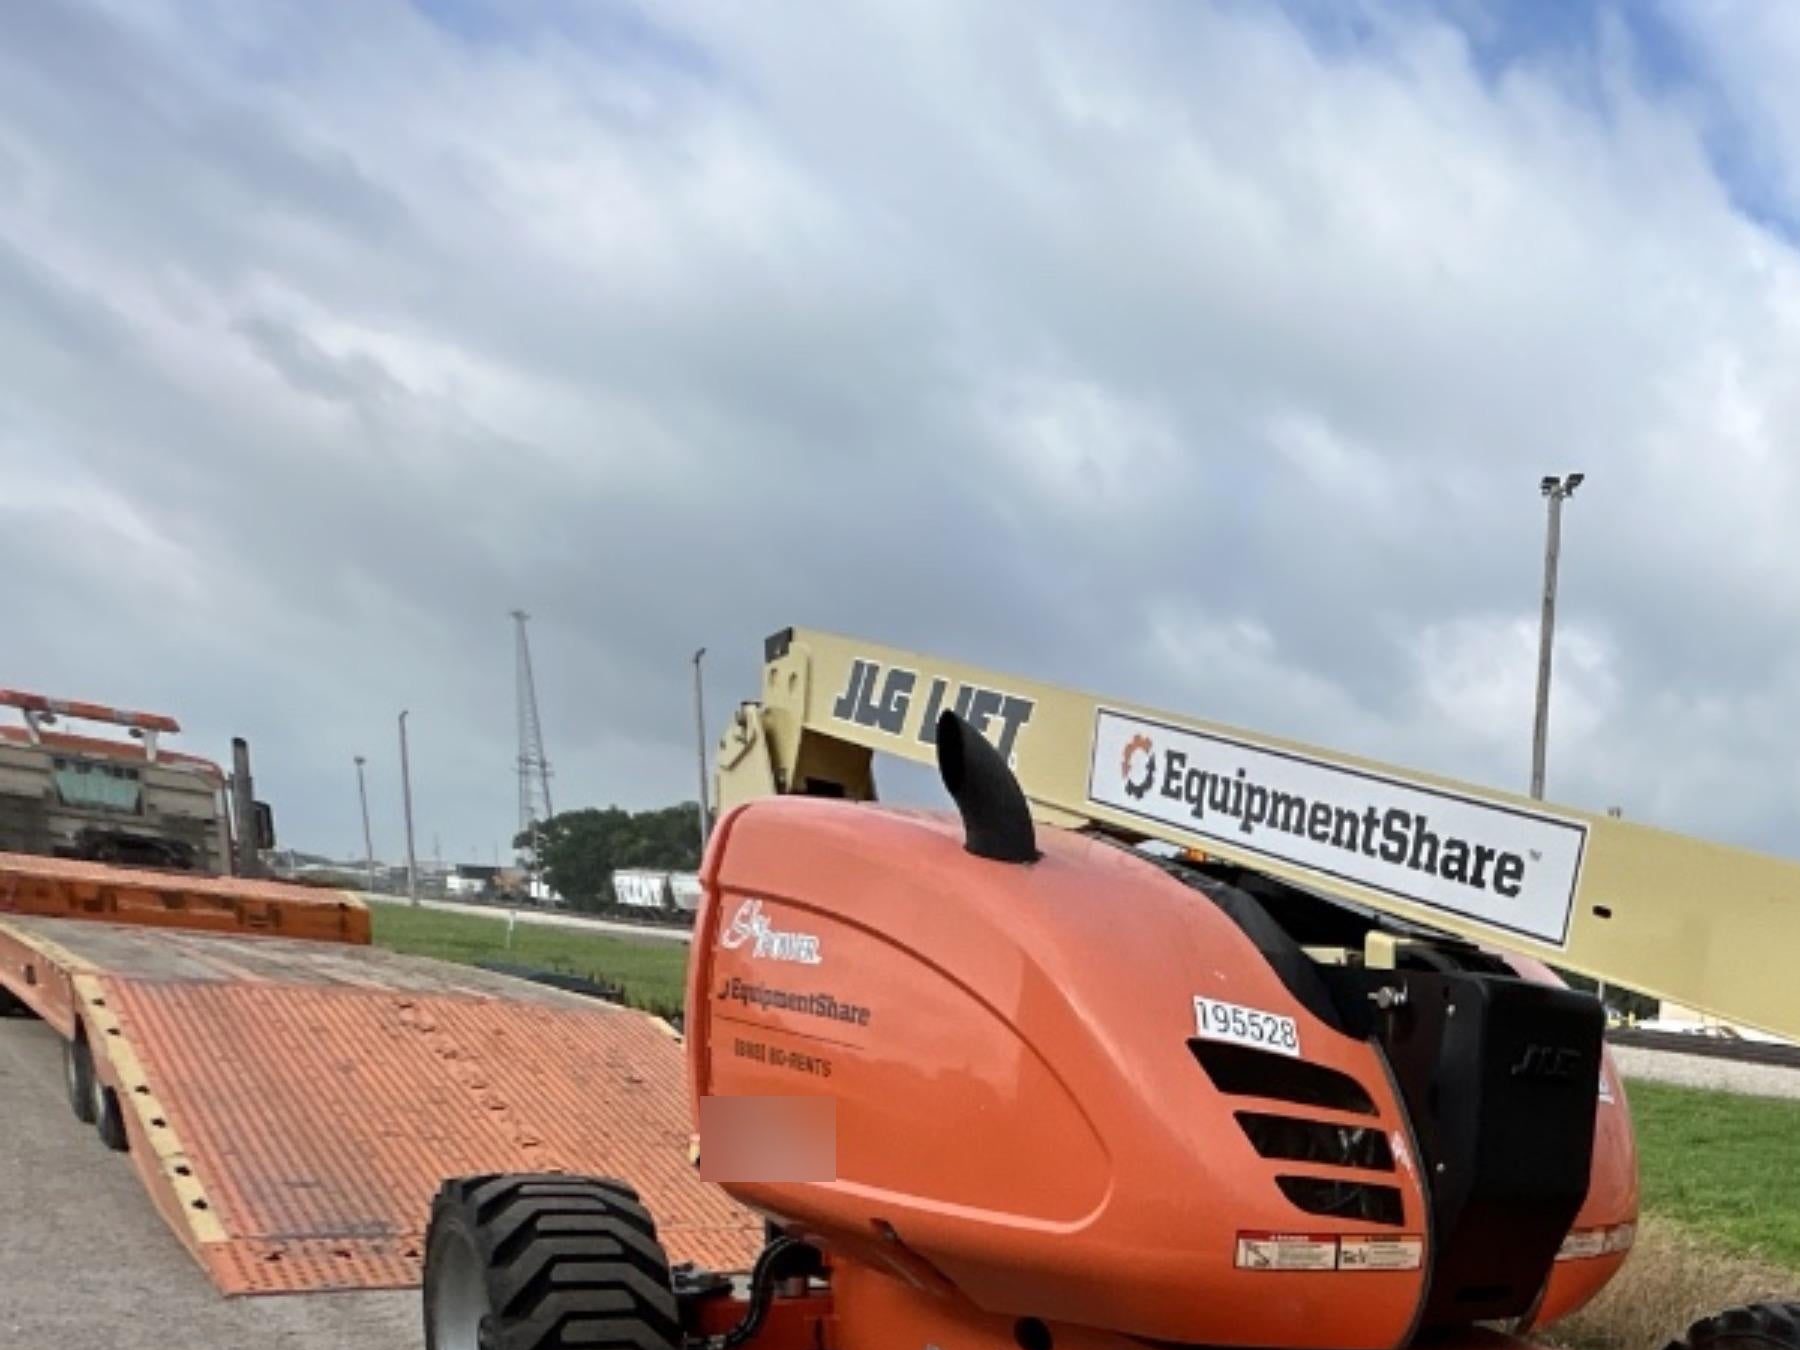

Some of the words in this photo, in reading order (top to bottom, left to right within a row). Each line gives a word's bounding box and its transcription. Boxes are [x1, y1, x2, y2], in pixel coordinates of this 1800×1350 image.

[832, 657, 919, 737] JLG
[1160, 749, 1526, 898] EquipmentShare
[731, 976, 871, 1027] EquipmentShare
[1196, 1000, 1297, 1049] 195528
